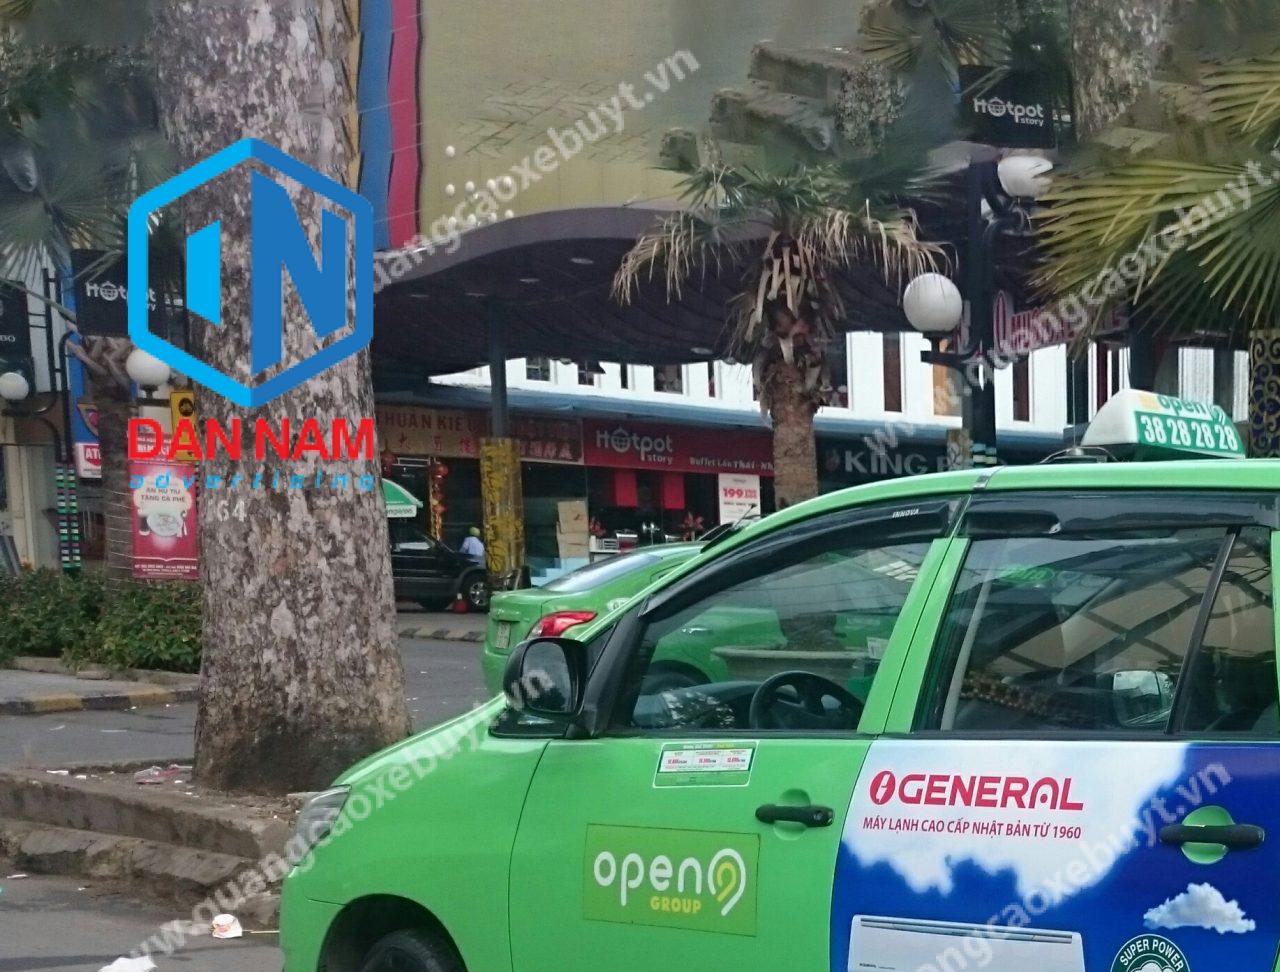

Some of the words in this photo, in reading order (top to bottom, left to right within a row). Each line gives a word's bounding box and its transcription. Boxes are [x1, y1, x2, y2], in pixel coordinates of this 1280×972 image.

[973, 97, 1044, 123] Hotpot
[1020, 117, 1044, 127] story
[596, 427, 673, 463] Hotpot
[1140, 415, 1167, 444] 38
[1166, 417, 1192, 447] 28
[1190, 421, 1216, 449] 28
[1214, 423, 1239, 451] 28
[646, 454, 673, 465] story
[844, 451, 928, 476] KING
[723, 487, 743, 499] 199
[892, 508, 919, 519] INNOVA
[898, 774, 1084, 811] GENERAL
[863, 815, 887, 830] MÁY
[889, 818, 919, 834] LẠNH
[921, 819, 945, 833] CAO
[947, 817, 970, 834] CẤP
[972, 820, 1004, 839] NHẬT
[1005, 819, 1031, 838] BẢN
[1034, 822, 1052, 838] TỪ
[1053, 826, 1082, 839] 1960
[594, 851, 703, 906] open
[650, 896, 702, 914] GROUP
[1120, 939, 1150, 966] SUPER
[1152, 939, 1184, 972] POWER
